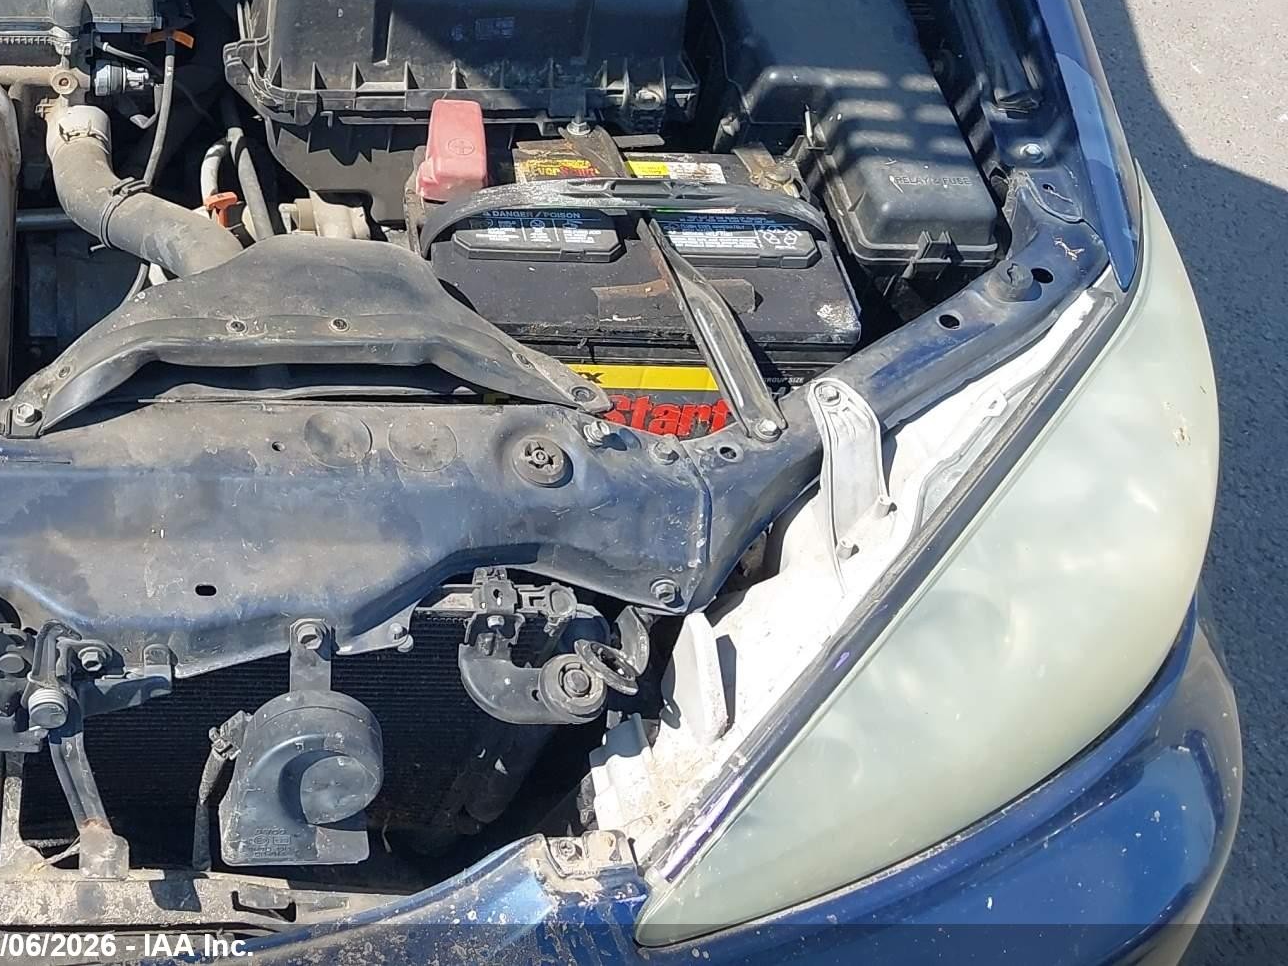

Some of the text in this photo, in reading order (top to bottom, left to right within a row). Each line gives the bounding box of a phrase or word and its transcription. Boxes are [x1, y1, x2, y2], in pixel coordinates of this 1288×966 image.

[895, 176, 929, 185] RELAY
[942, 177, 972, 186] FUSE
[543, 211, 581, 219] POISON
[603, 394, 731, 436] Start
